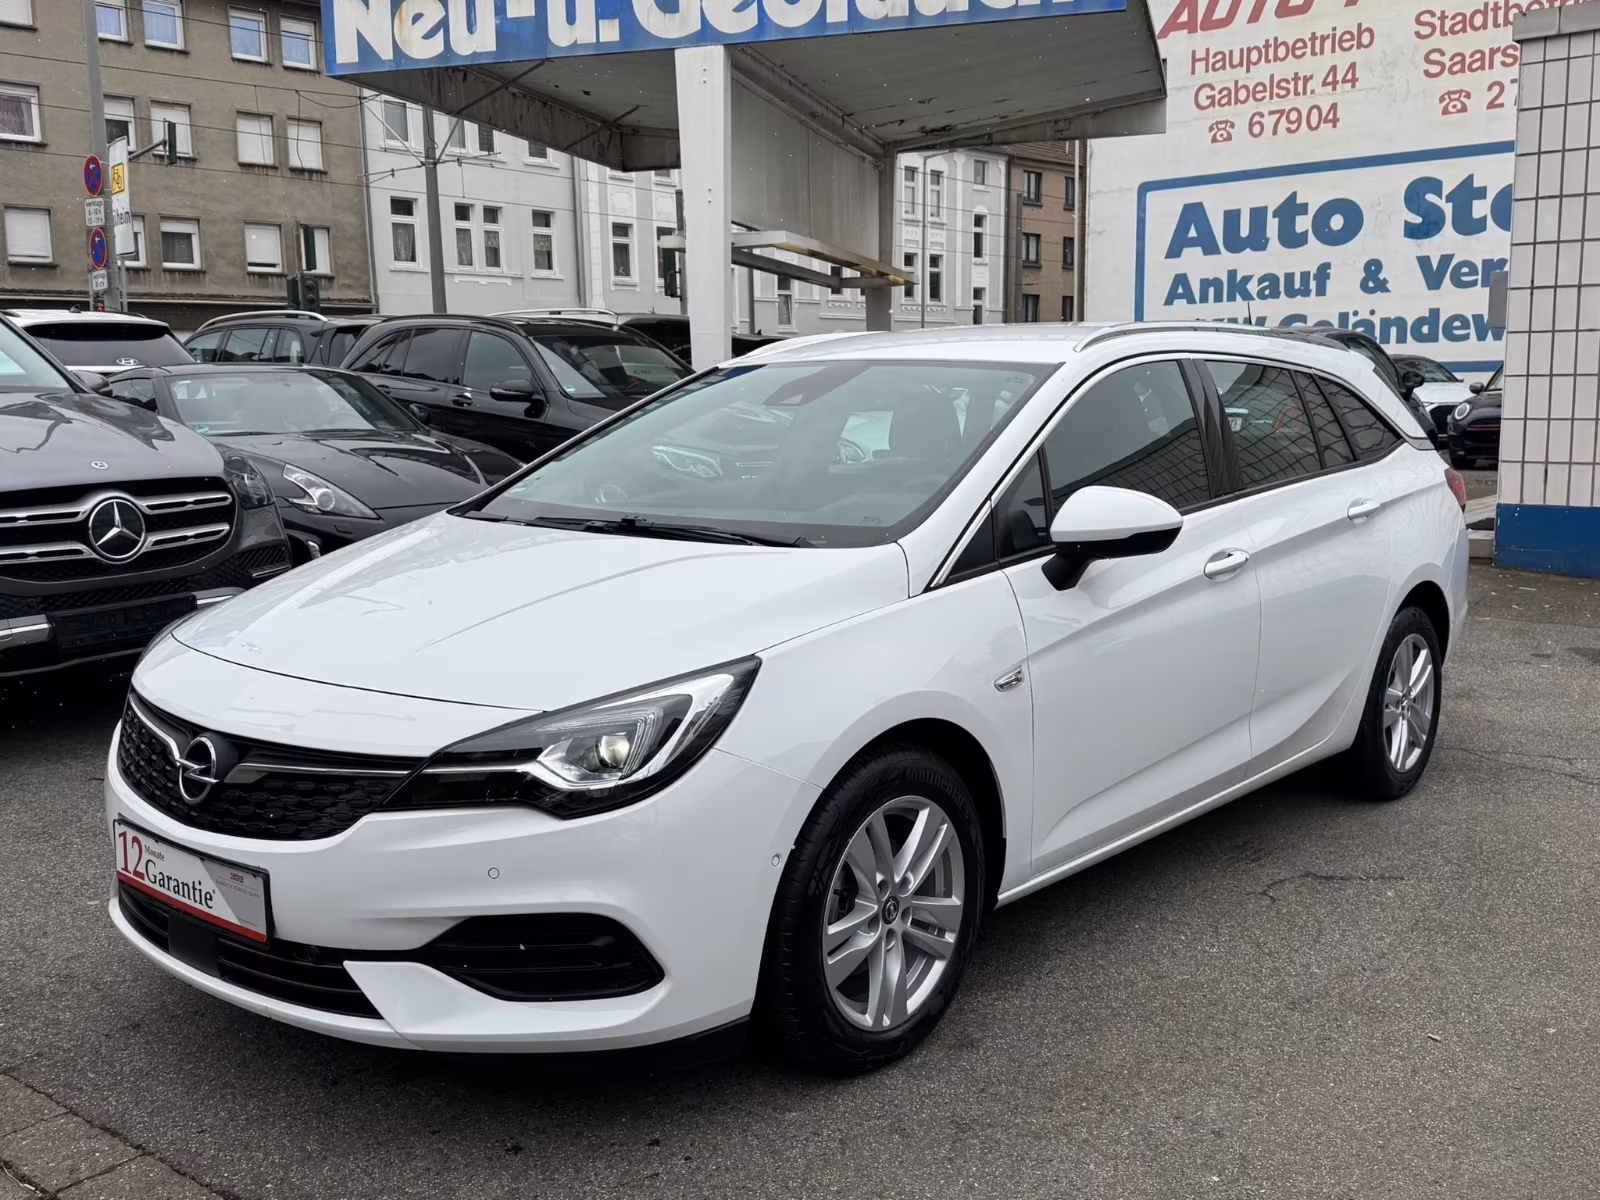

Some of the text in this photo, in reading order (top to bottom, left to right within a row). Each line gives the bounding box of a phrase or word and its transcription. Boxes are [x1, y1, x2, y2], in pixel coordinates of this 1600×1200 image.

[1190, 22, 1375, 76] Hauptbetrieb
[1193, 62, 1360, 112] Gabelstr. 44
[1247, 103, 1341, 139] 67904
[1165, 190, 1364, 260] Auto
[1163, 262, 1332, 307] Ankauf
[1360, 257, 1391, 295] &
[118, 831, 145, 883] 12
